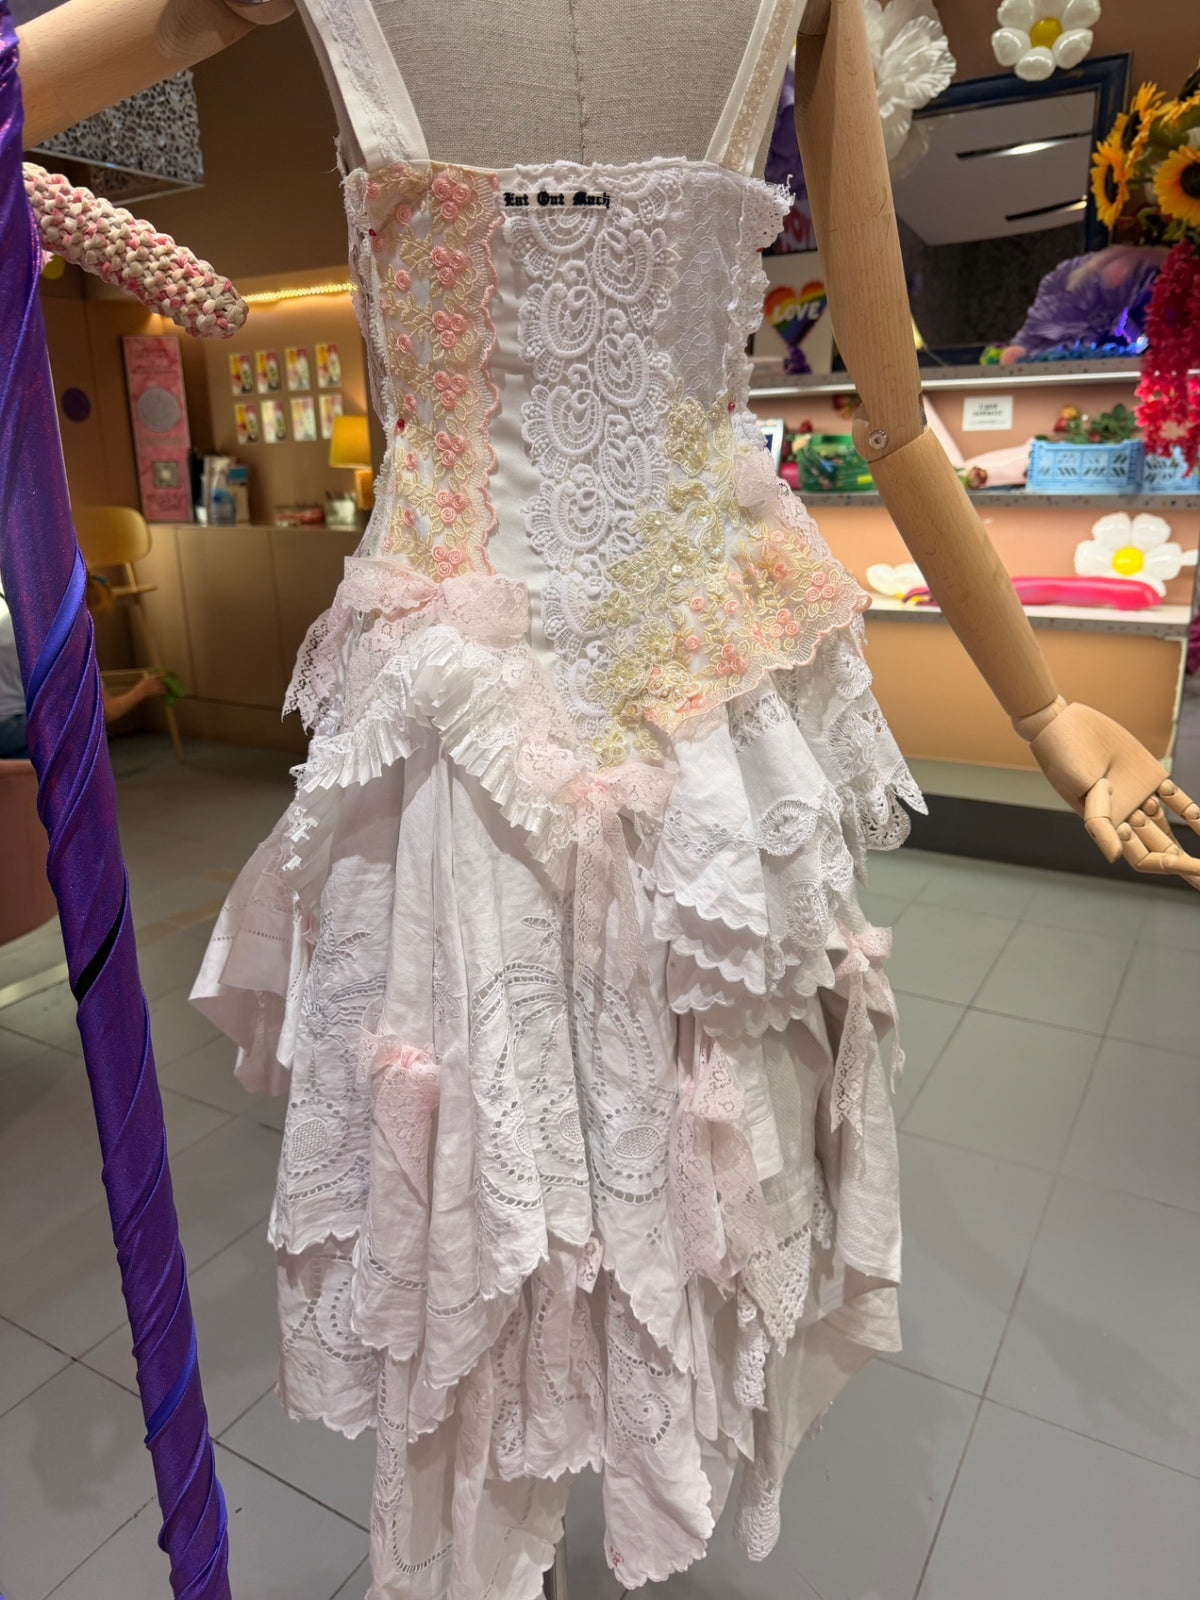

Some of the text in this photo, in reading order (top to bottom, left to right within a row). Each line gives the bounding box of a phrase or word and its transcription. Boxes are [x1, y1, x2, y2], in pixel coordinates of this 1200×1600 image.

[536, 190, 565, 206] Out
[572, 191, 611, 209] Much
[772, 300, 821, 324] LOVE
